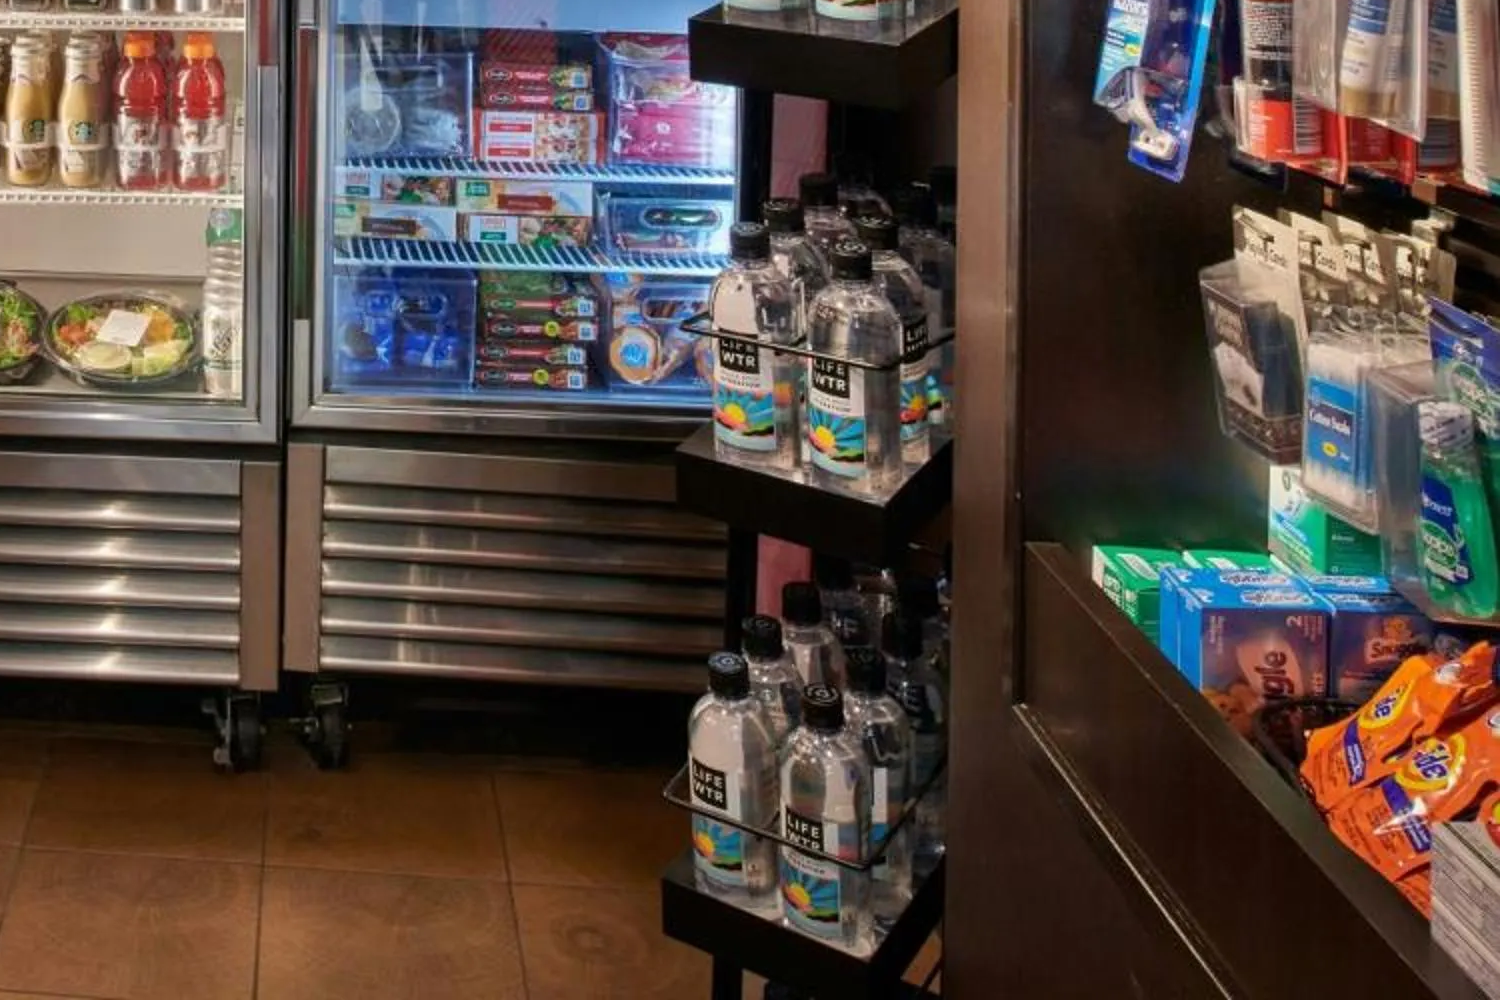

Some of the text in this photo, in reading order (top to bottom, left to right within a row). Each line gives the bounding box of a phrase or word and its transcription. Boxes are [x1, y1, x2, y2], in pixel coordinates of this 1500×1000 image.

[721, 352, 756, 367] WTR
[814, 358, 845, 376] LIFE
[814, 374, 846, 392] WTR
[692, 762, 723, 788] LIFE
[692, 781, 724, 803] WTR
[787, 812, 820, 839] LIFE
